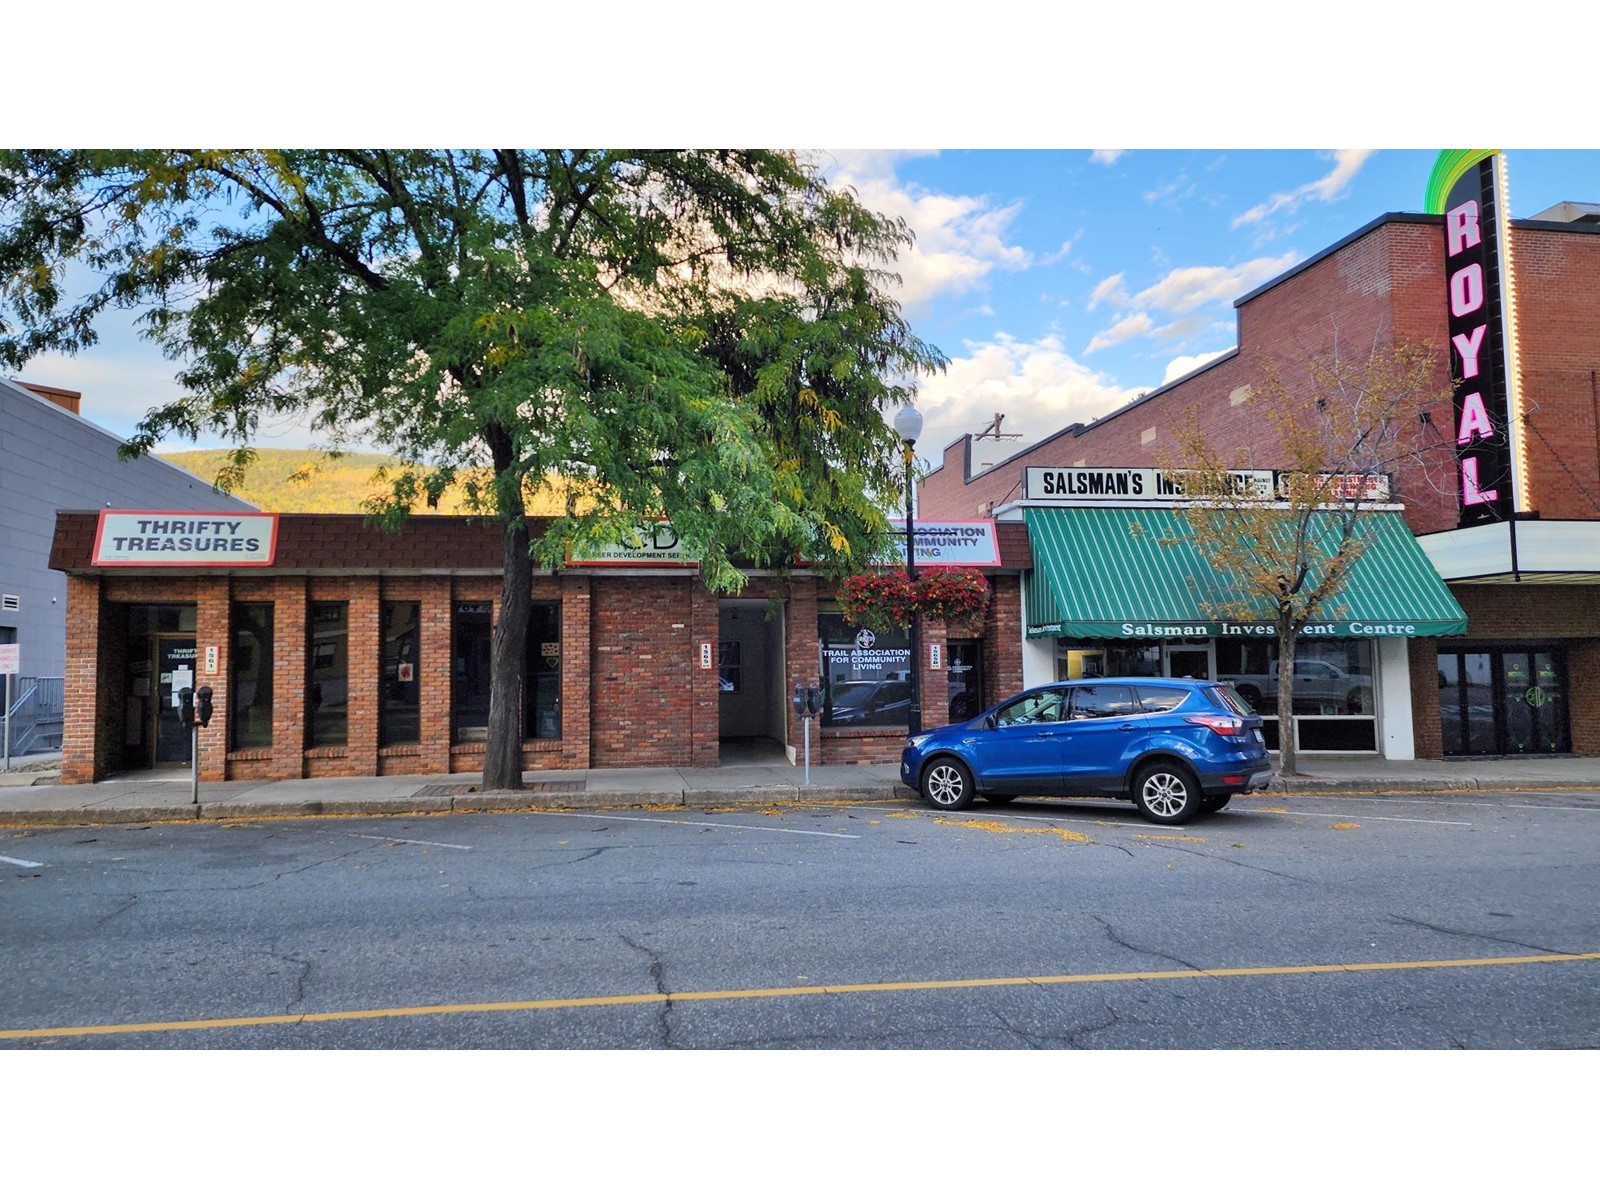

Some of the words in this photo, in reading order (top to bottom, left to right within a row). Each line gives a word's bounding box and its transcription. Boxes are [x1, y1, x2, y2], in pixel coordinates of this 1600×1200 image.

[1447, 200, 1498, 506] ROYAL
[1043, 470, 1143, 495] SALSMAN'S
[137, 520, 242, 535] THRIFTY
[112, 537, 260, 552] TREASURES
[1121, 623, 1208, 636] Salsman
[1221, 622, 1335, 635] Invesent
[1349, 622, 1416, 634] Centre
